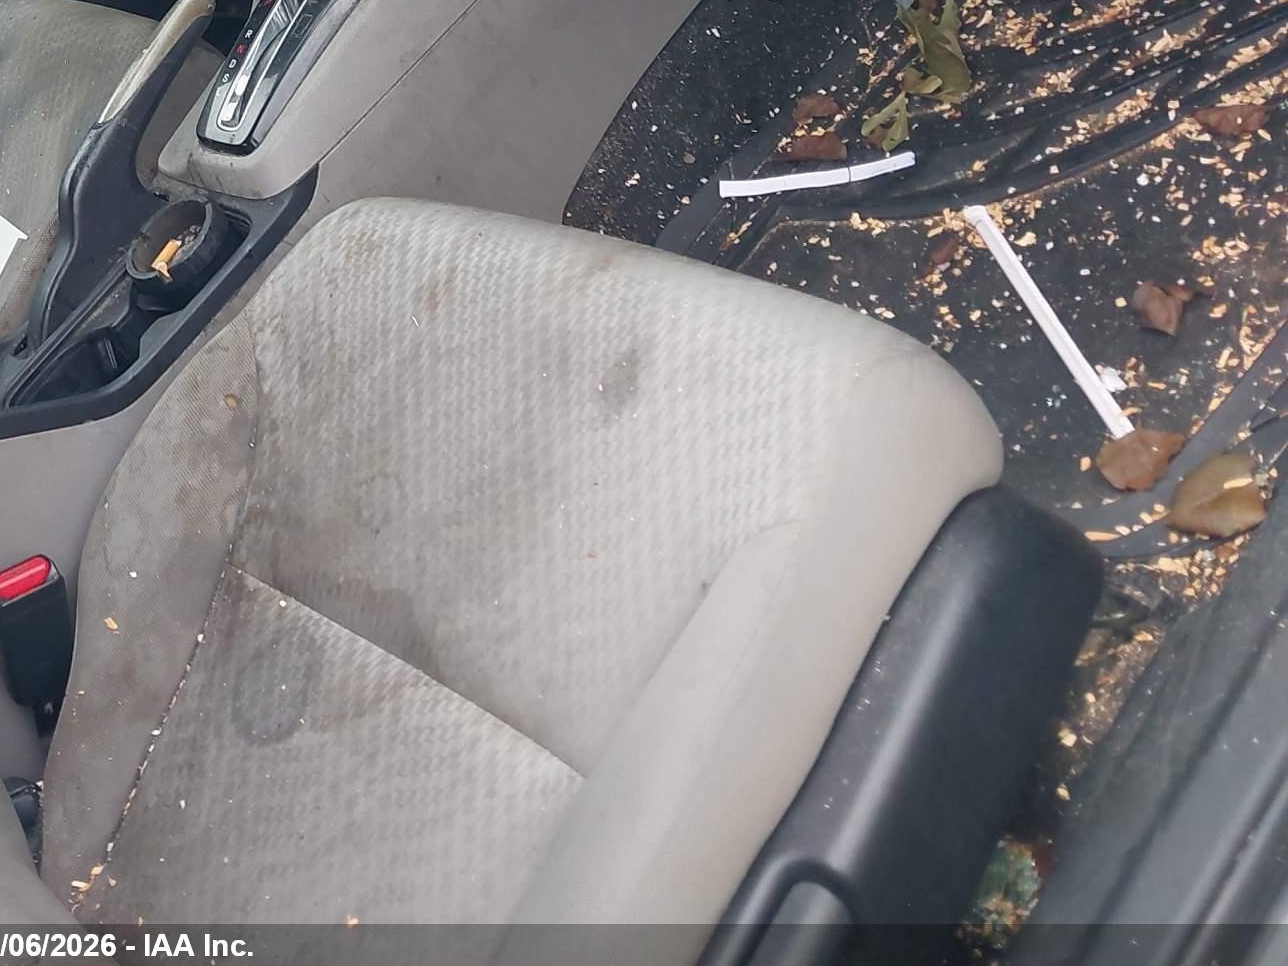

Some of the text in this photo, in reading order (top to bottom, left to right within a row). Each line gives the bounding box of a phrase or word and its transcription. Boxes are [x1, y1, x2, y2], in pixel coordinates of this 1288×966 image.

[244, 29, 254, 39] R
[229, 59, 237, 69] D
[222, 73, 230, 83] S
